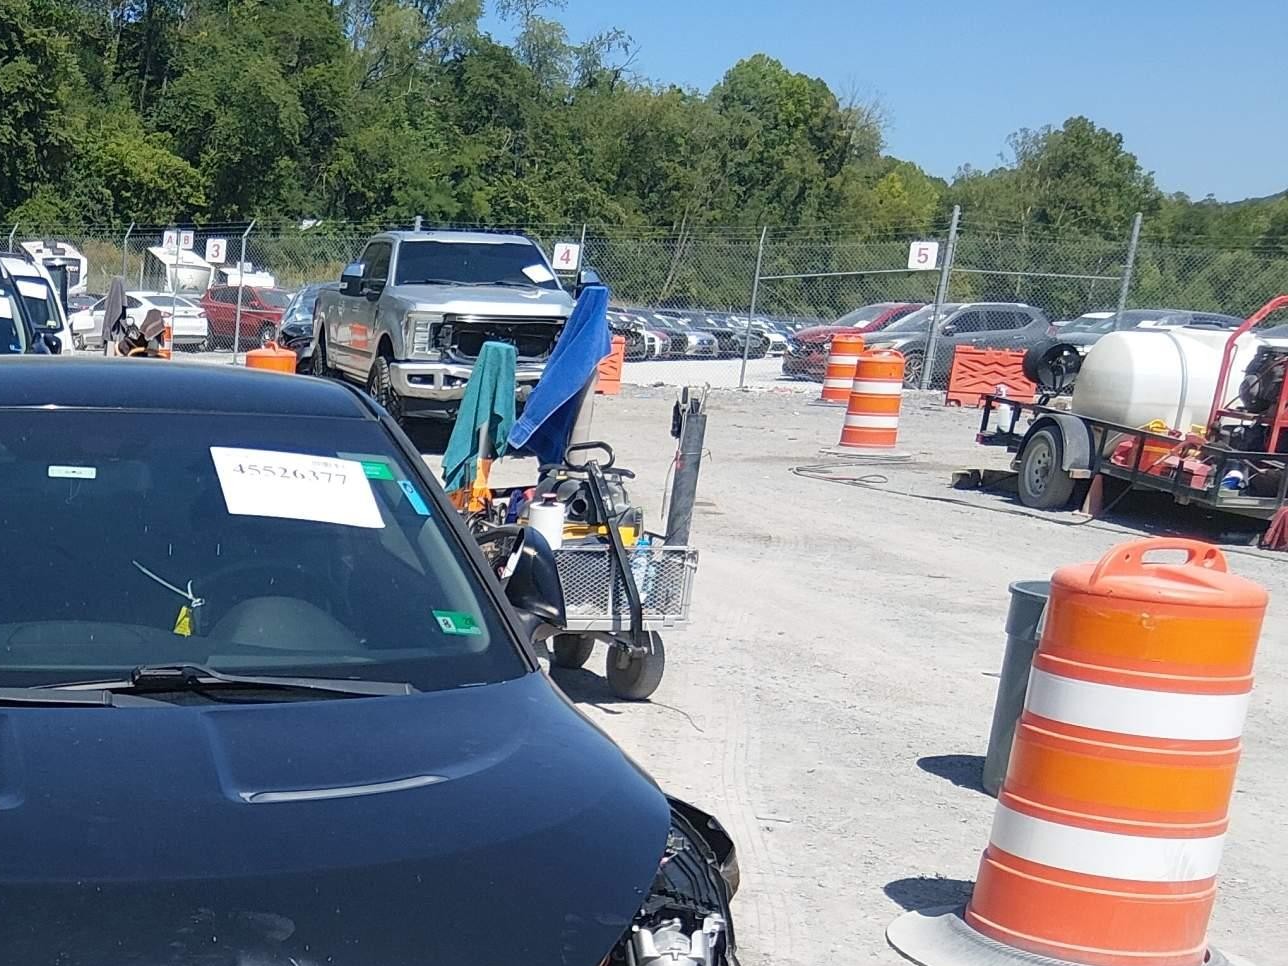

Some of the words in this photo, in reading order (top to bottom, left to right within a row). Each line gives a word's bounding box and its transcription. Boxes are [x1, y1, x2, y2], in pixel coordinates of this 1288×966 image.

[166, 235, 174, 244] A
[183, 235, 190, 245] B
[211, 243, 221, 258] 3
[560, 249, 571, 264] 4
[917, 247, 929, 264] 5
[232, 463, 347, 485] 45526377
